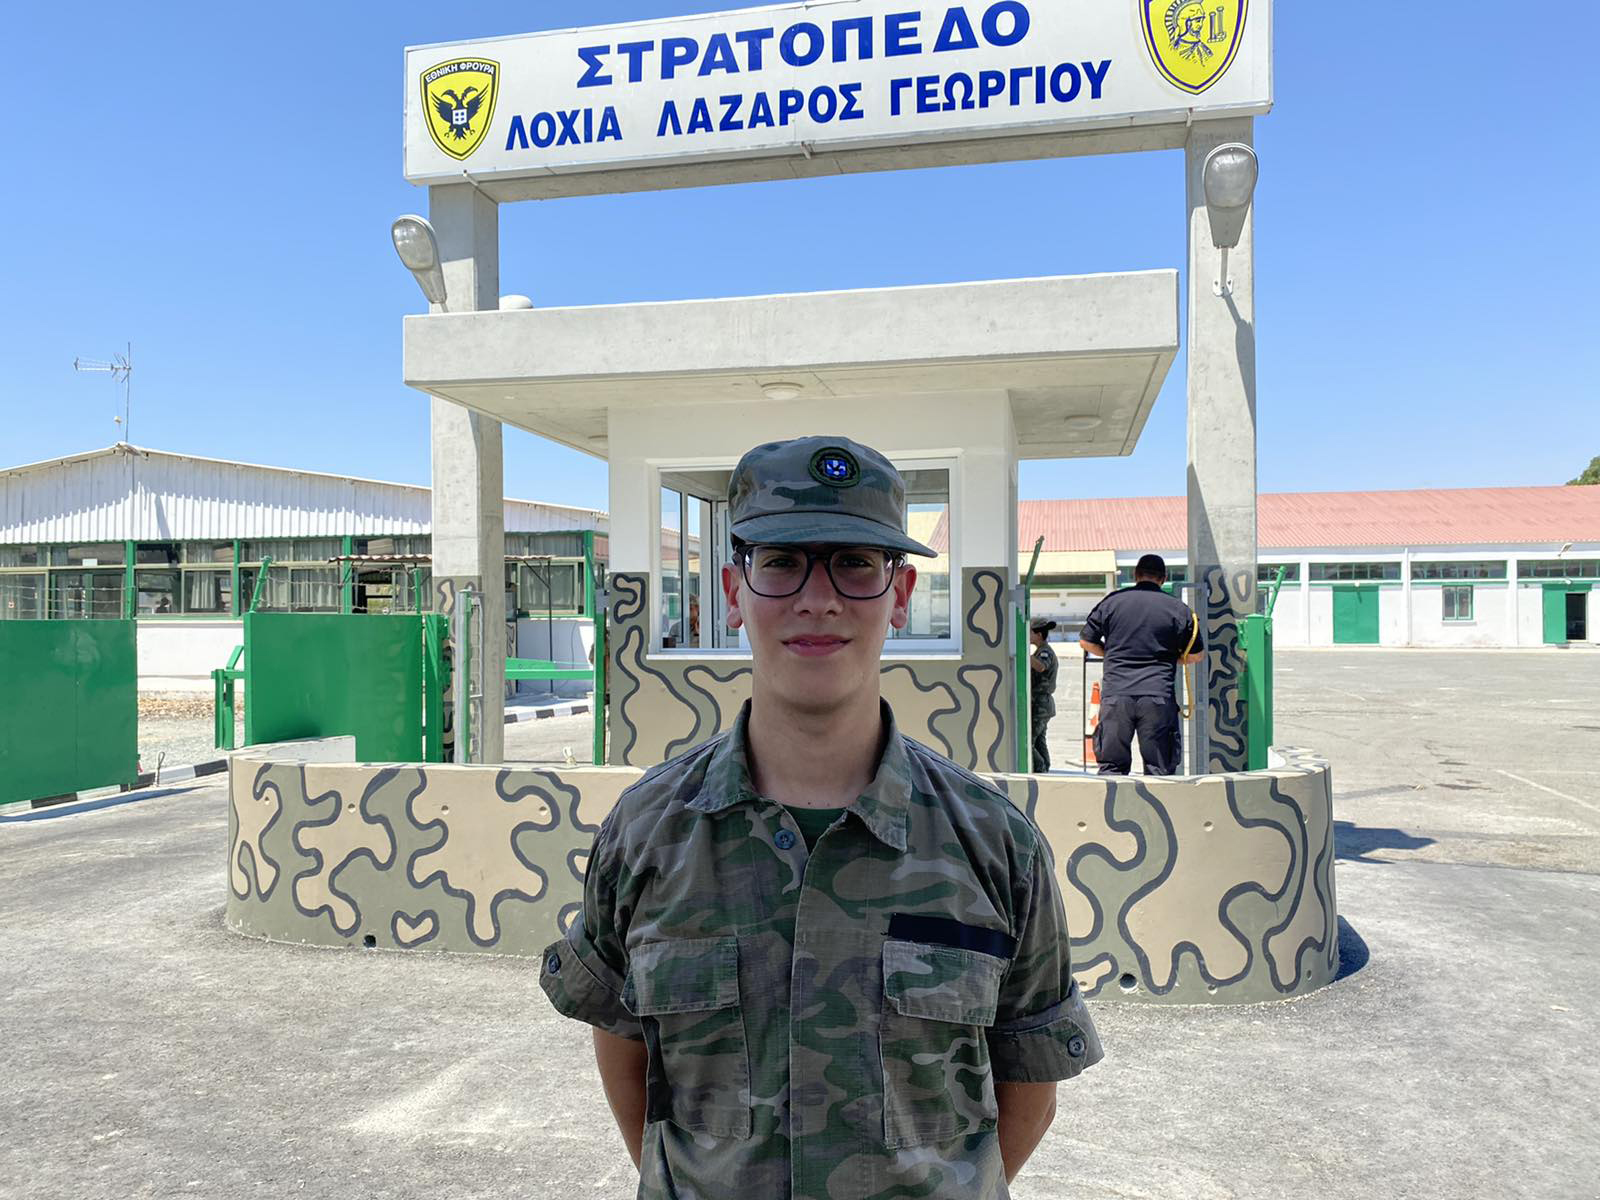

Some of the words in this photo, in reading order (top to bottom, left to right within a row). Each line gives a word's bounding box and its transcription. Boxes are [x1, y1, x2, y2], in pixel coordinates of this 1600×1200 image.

[425, 63, 458, 83] ΕΘΝΙΚΗ
[459, 62, 495, 75] ΦΡΟΥΡΑ
[576, 0, 1030, 88] ΣΤΡΑΤΟΠΕΔΟ
[505, 106, 623, 151] ΛΟΧΙΑ
[656, 82, 864, 137] ΛΑΖΑΡΟΣ
[890, 59, 1112, 117] ΓΕΩΡΓΙΟΥ
